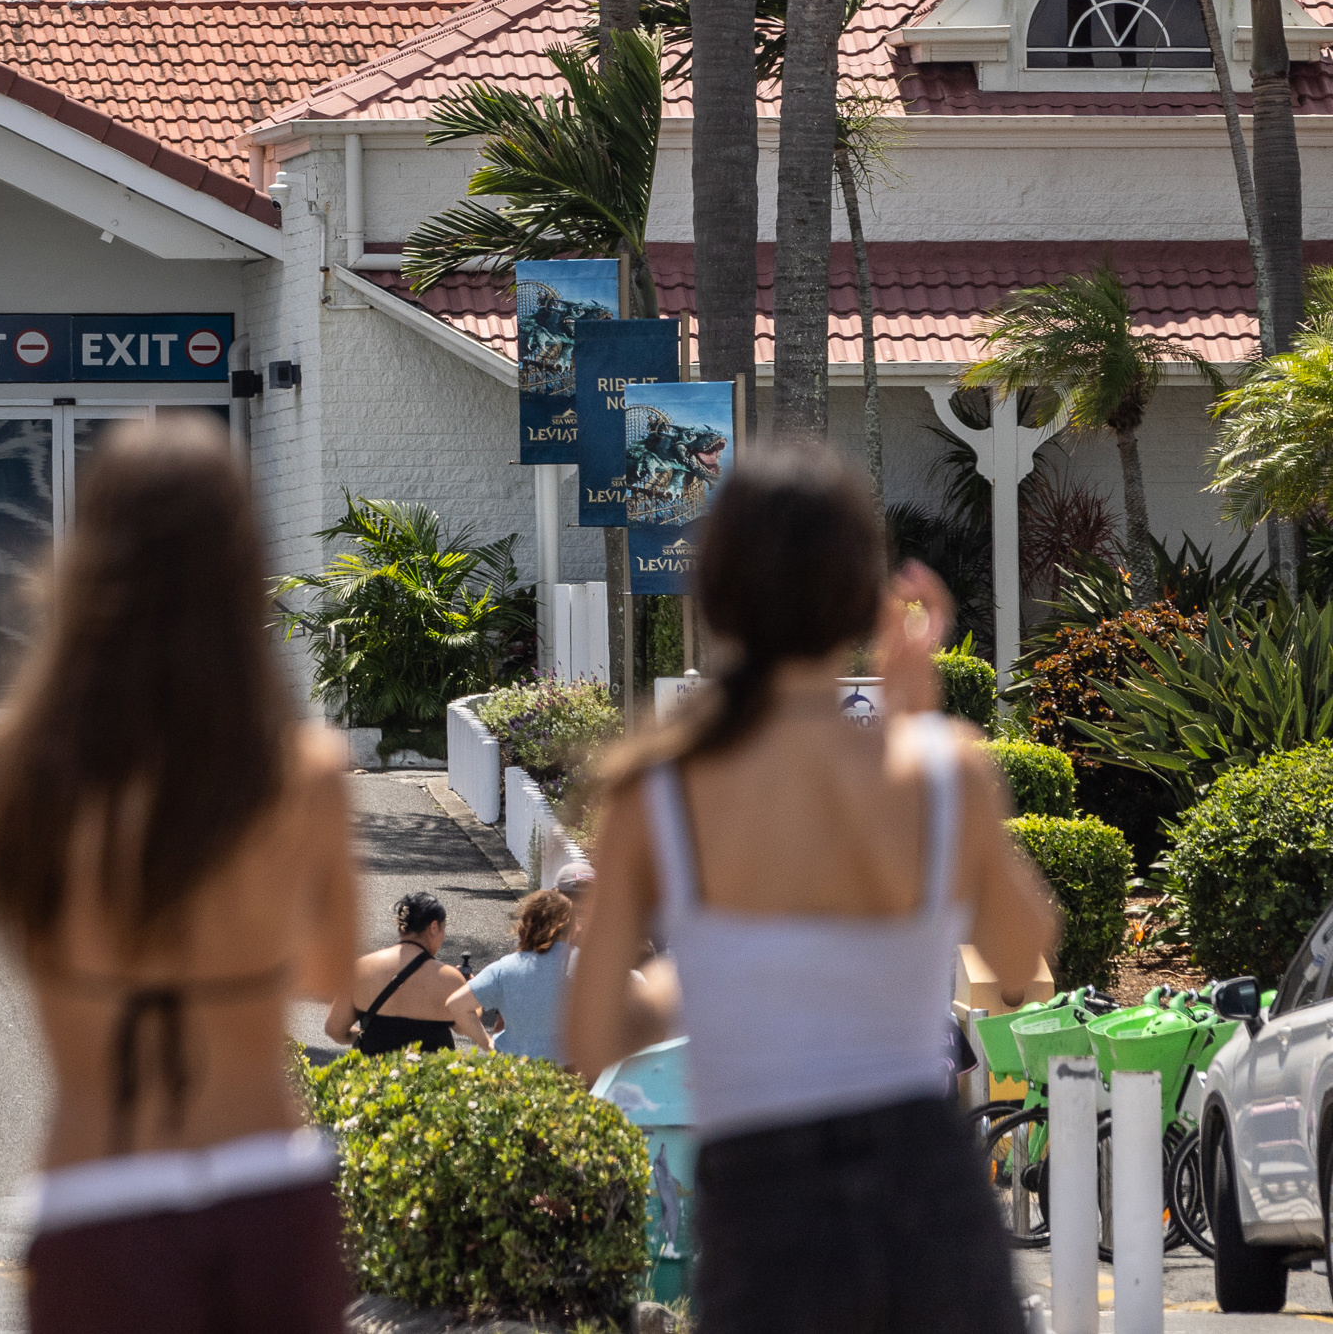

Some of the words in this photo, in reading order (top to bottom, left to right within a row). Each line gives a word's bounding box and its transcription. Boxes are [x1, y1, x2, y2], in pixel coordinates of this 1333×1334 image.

[81, 333, 179, 366] EXIT
[527, 426, 578, 444] LEVIAT
[586, 487, 627, 503] LEVIA
[662, 548, 675, 556] SEA
[636, 556, 694, 574] LEVIAT
